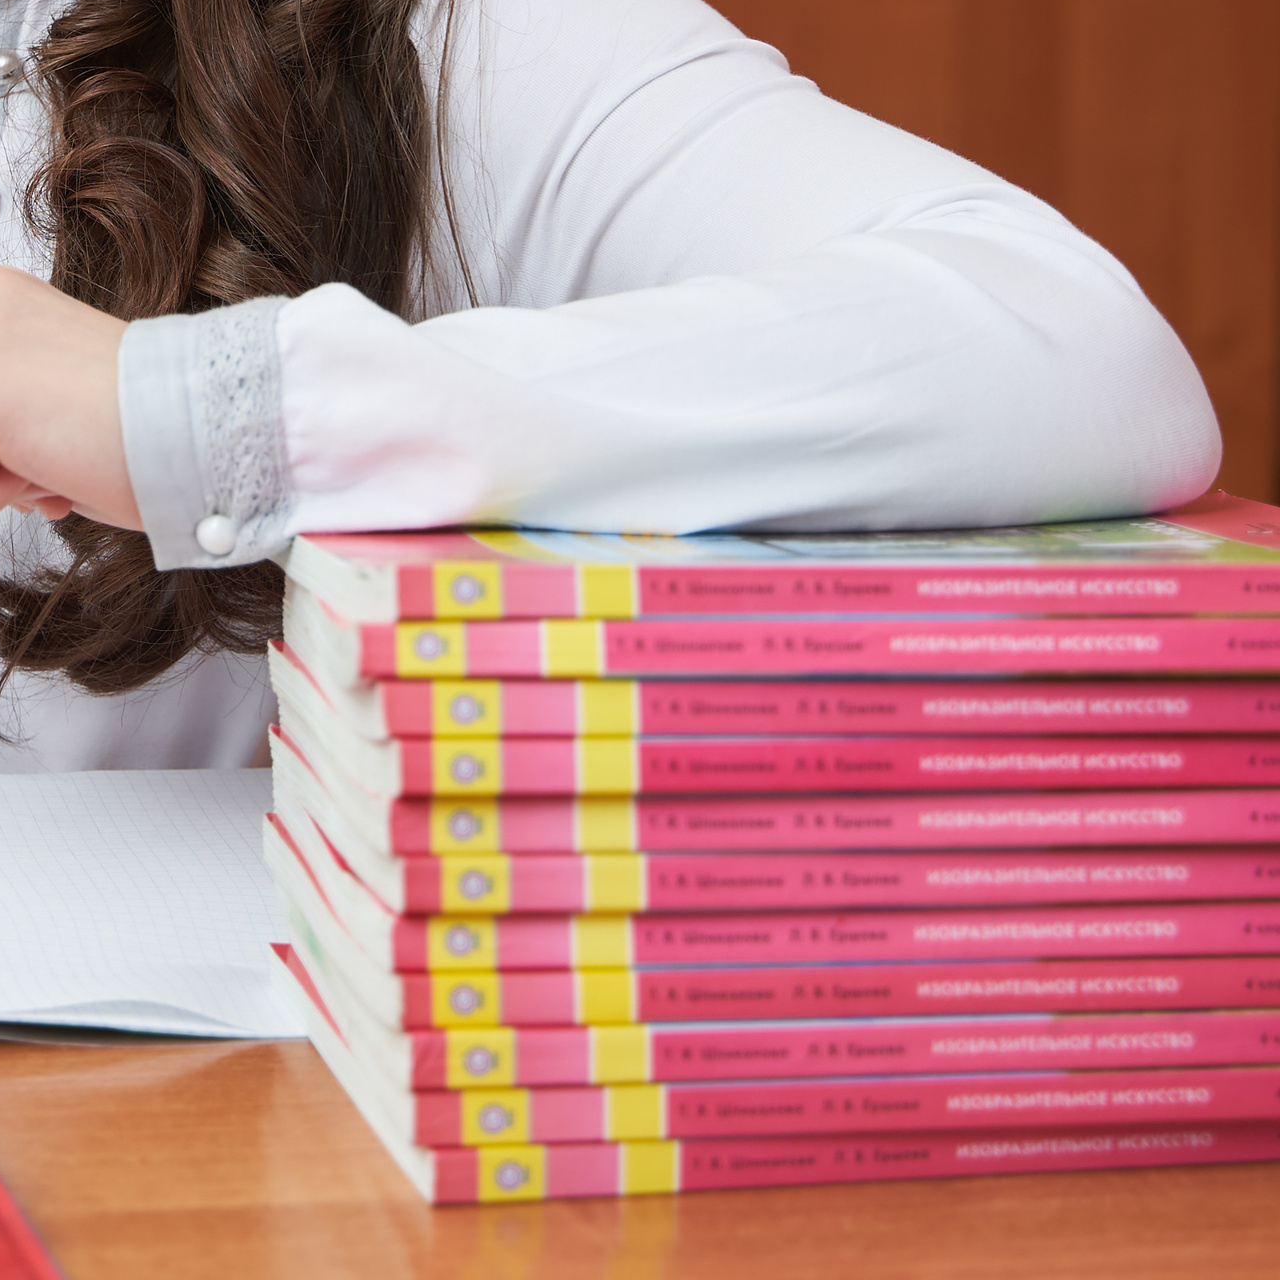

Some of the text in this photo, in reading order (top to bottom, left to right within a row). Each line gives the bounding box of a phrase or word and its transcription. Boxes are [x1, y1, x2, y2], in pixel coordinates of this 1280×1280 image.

[917, 579, 1078, 595] ИЗОБРАЗИТЕЛЬНОЕ
[1080, 579, 1178, 595] ИСКУССТВО
[888, 635, 1056, 653] ИЗОБРАЗИТЕЛЬНОЕ
[1058, 634, 1161, 652] ИСКУССТВО
[923, 698, 1086, 715] ИЗОБРАЗИТЕЛЬНОЕ
[1089, 698, 1189, 715] ИСКУССТВО
[919, 754, 1081, 772] ИЗОБРАЗИТЕЛЬНОЕ
[1083, 751, 1183, 770] ИСКУССТВО
[918, 809, 1081, 829] ИЗОБРАЗИТЕЛЬНОЕ
[1084, 807, 1184, 826] ИСКУССТВО
[926, 866, 1087, 886] ИЗОБРАЗИТЕЛЬНОЕ
[1090, 864, 1189, 883] ИСКУССТВО
[913, 922, 1075, 941] ИЗОБРАЗИТЕЛЬНОЕ
[1078, 920, 1178, 939] ИСКУССТВО
[917, 979, 1077, 997] ИЗОБРАЗИТЕЛЬНОЕ
[1080, 976, 1179, 994] ИСКУССТВО
[931, 1034, 1092, 1055] ИЗОБРАЗИТЕЛЬНОЕ
[1096, 1031, 1194, 1051] ИСКУССТВО
[947, 1090, 1108, 1111] ИЗОБРАЗИТЕЛЬНОЕ
[1111, 1087, 1210, 1106] ИСКУССТВО
[957, 1137, 1113, 1159] ИЗОБРАЗИТЕЛЬНОЕ
[1116, 1131, 1213, 1151] ИСКУССТВО
